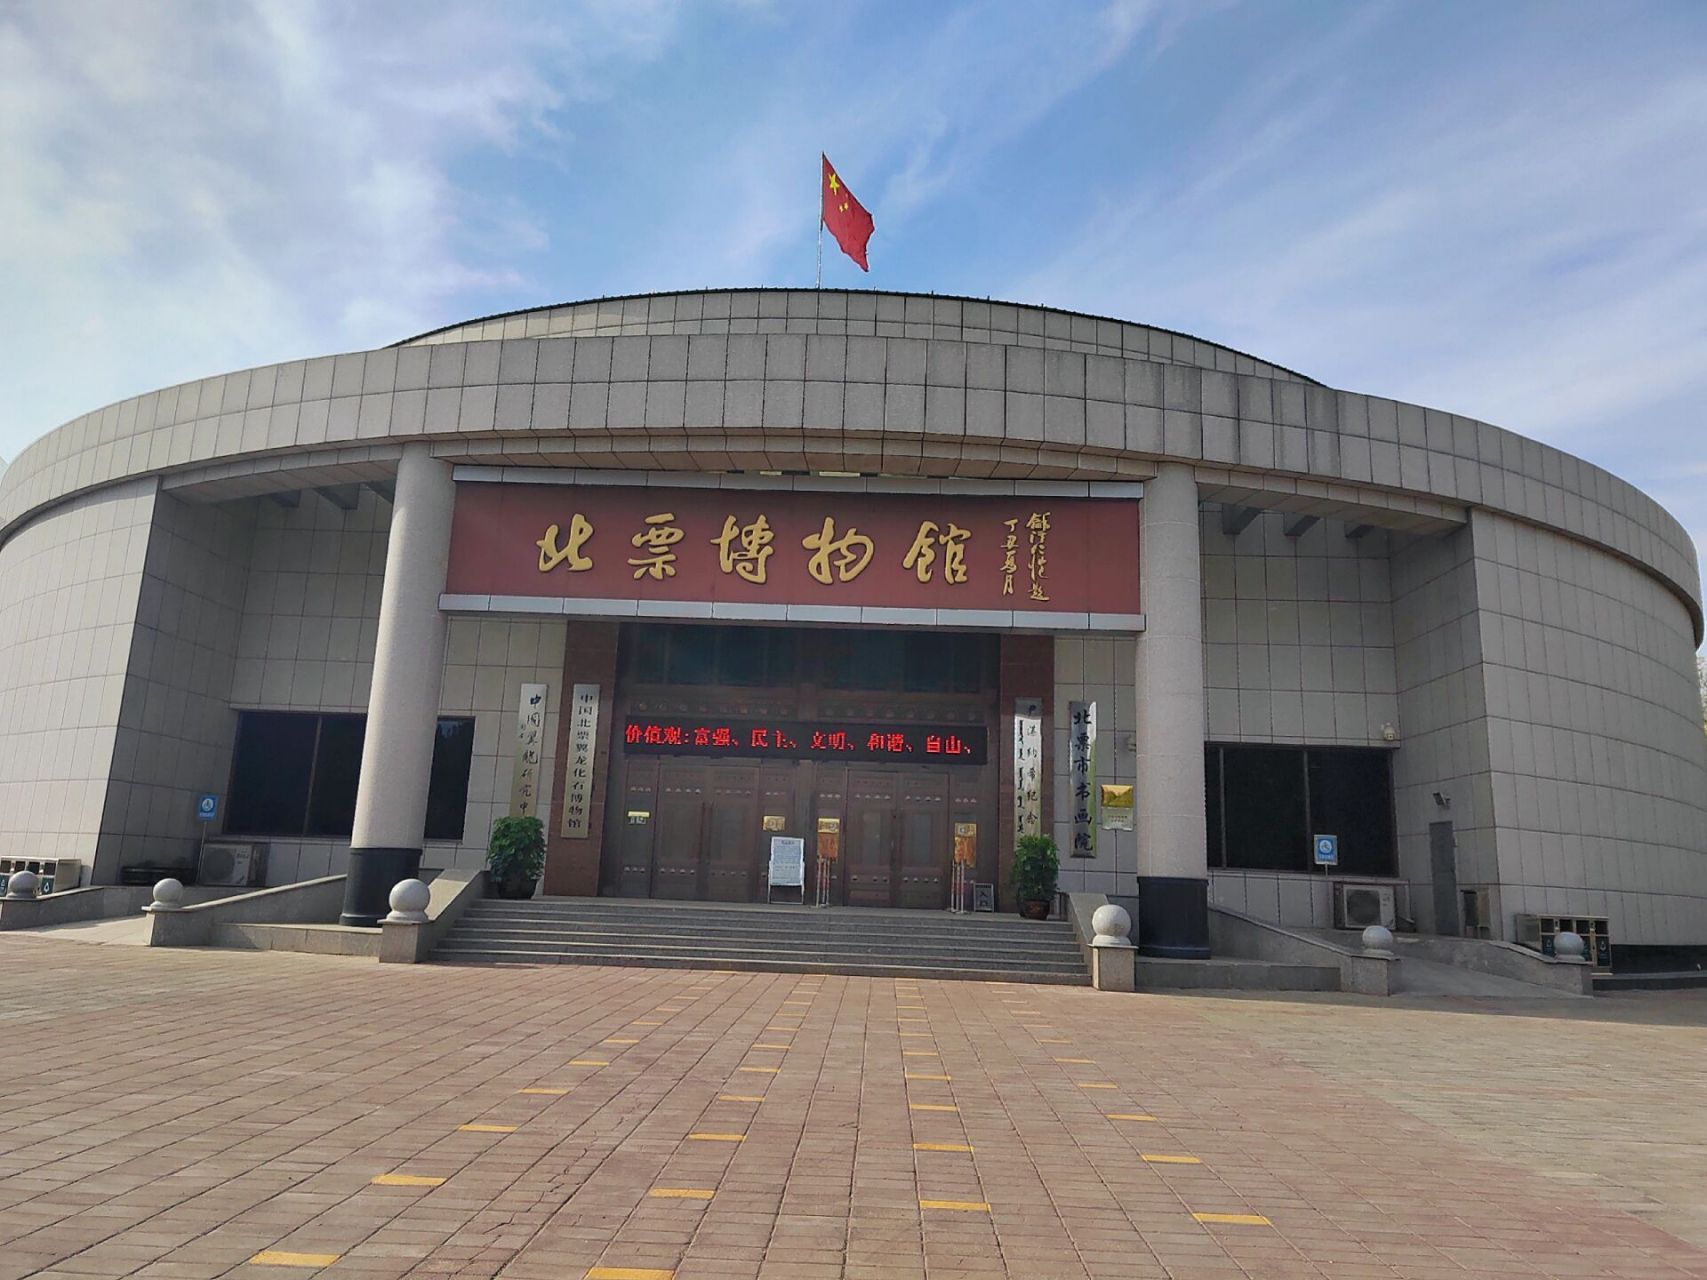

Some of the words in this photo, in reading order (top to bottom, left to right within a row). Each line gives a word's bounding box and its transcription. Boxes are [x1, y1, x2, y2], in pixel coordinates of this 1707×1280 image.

[1073, 709, 1093, 851] 北票市书画院
